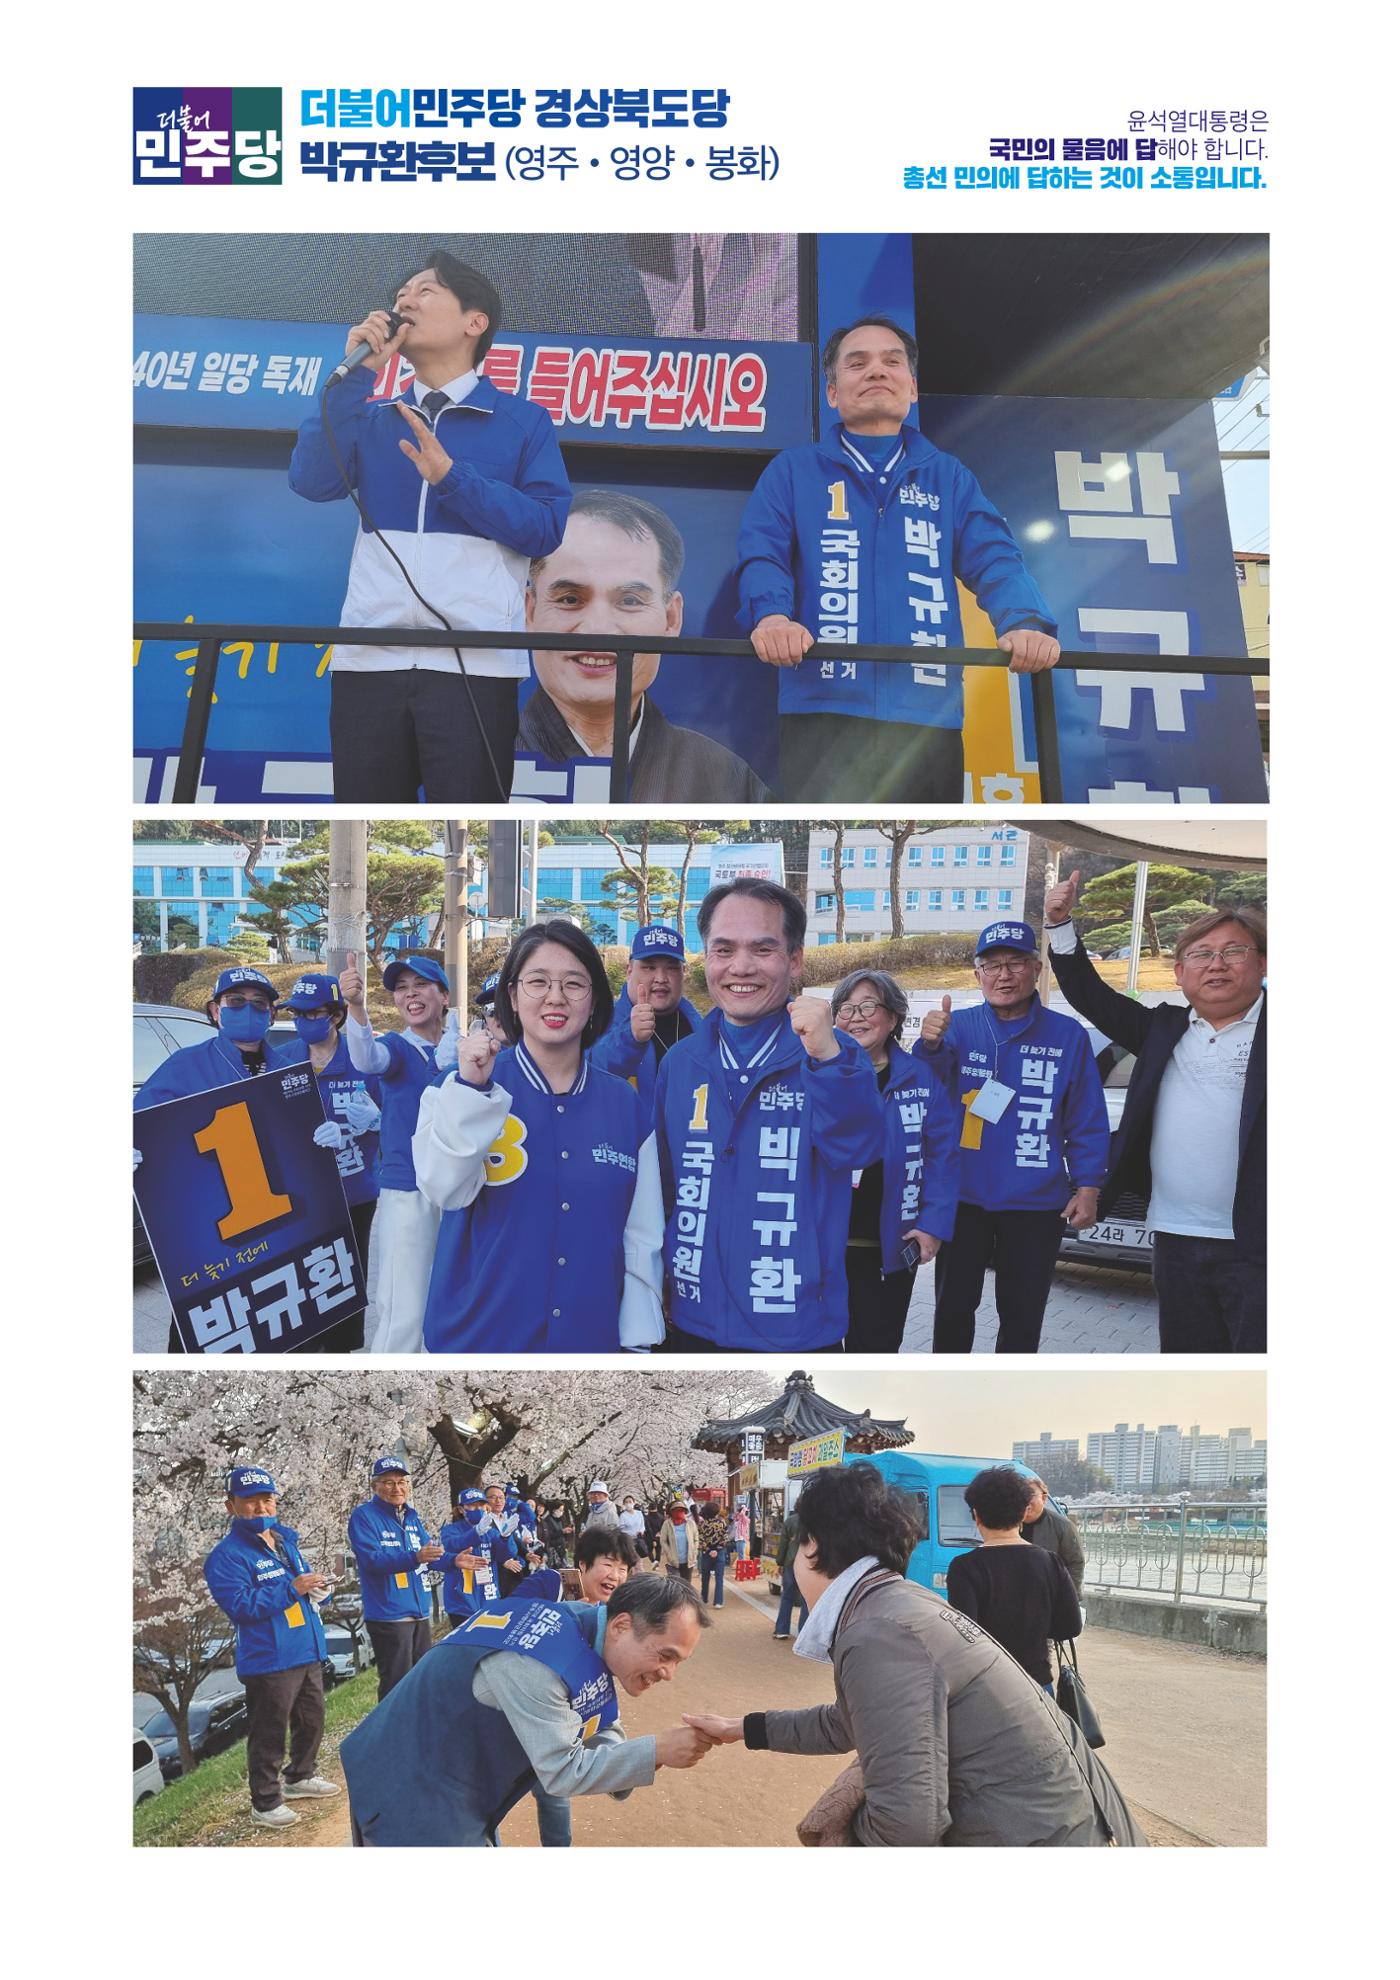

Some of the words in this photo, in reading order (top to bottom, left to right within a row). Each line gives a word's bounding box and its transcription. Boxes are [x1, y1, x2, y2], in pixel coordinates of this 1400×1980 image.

[198, 352, 258, 394] 일당
[262, 356, 323, 396] 독재
[527, 346, 769, 432] 들어주십시오
[827, 481, 849, 521] 1
[900, 488, 940, 511] 민주당
[643, 933, 679, 947] 민주당
[985, 927, 1025, 943] 민주당
[281, 1074, 309, 1091] 민주당
[688, 1083, 709, 1133] 1
[1013, 1058, 1058, 1169] 박규환
[193, 1101, 293, 1241] 1
[672, 1140, 716, 1284] 국회의원
[1088, 1224, 1125, 1242] 24라
[181, 1274, 200, 1287] 더
[203, 1257, 231, 1281] 늦기
[235, 1240, 269, 1264] 전에
[188, 1236, 358, 1354] 박규환
